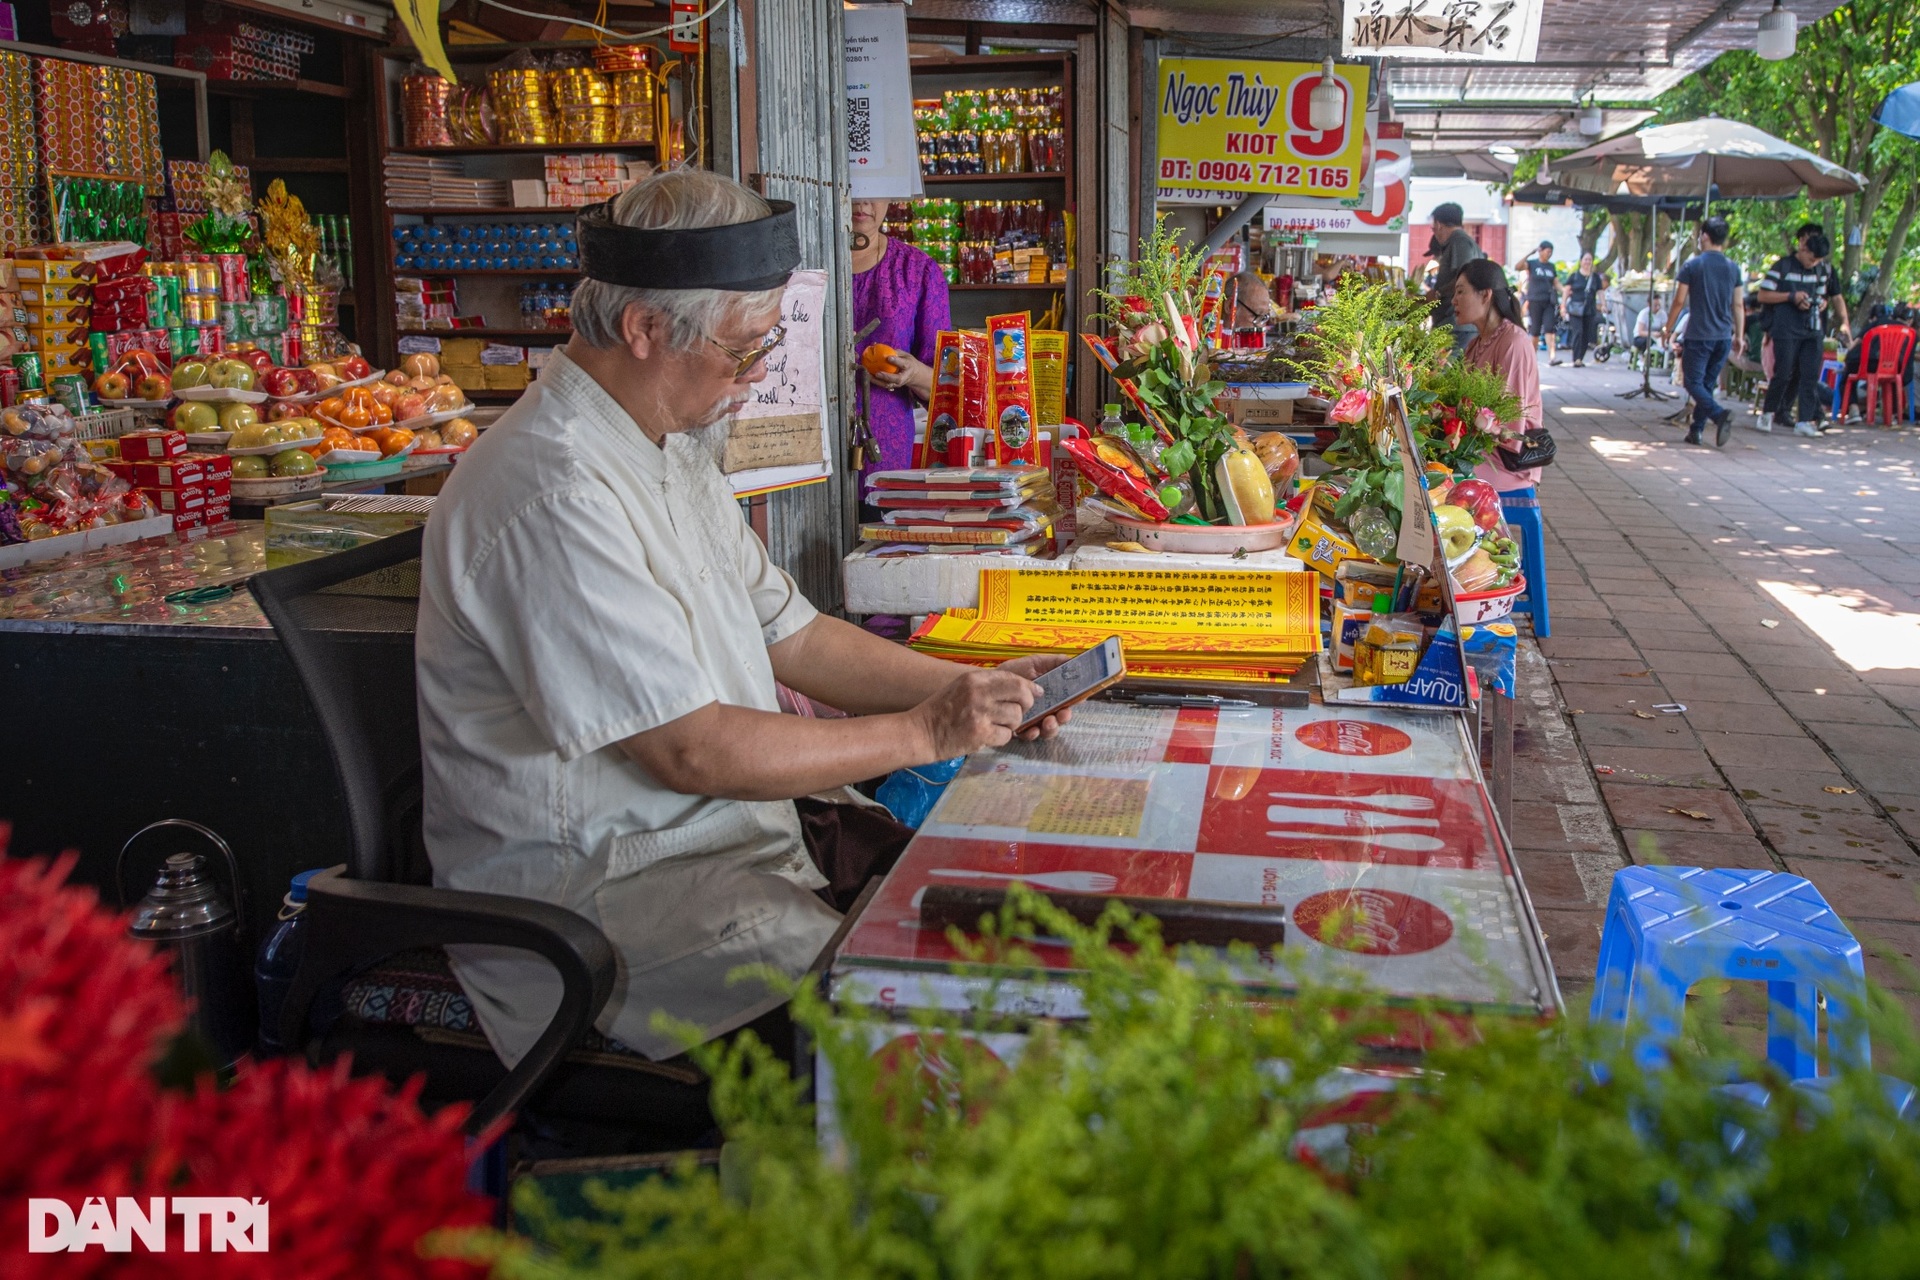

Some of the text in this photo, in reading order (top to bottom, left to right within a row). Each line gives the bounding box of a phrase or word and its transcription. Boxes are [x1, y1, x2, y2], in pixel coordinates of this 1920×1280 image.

[1163, 72, 1279, 127] Ngọc Thùy
[1290, 75, 1348, 156] 9
[1226, 132, 1278, 155] KIOT
[1160, 159, 1349, 188] ĐT: 0904 712 165
[1328, 219, 1351, 229] 4667
[1383, 677, 1465, 706] AQUAFI
